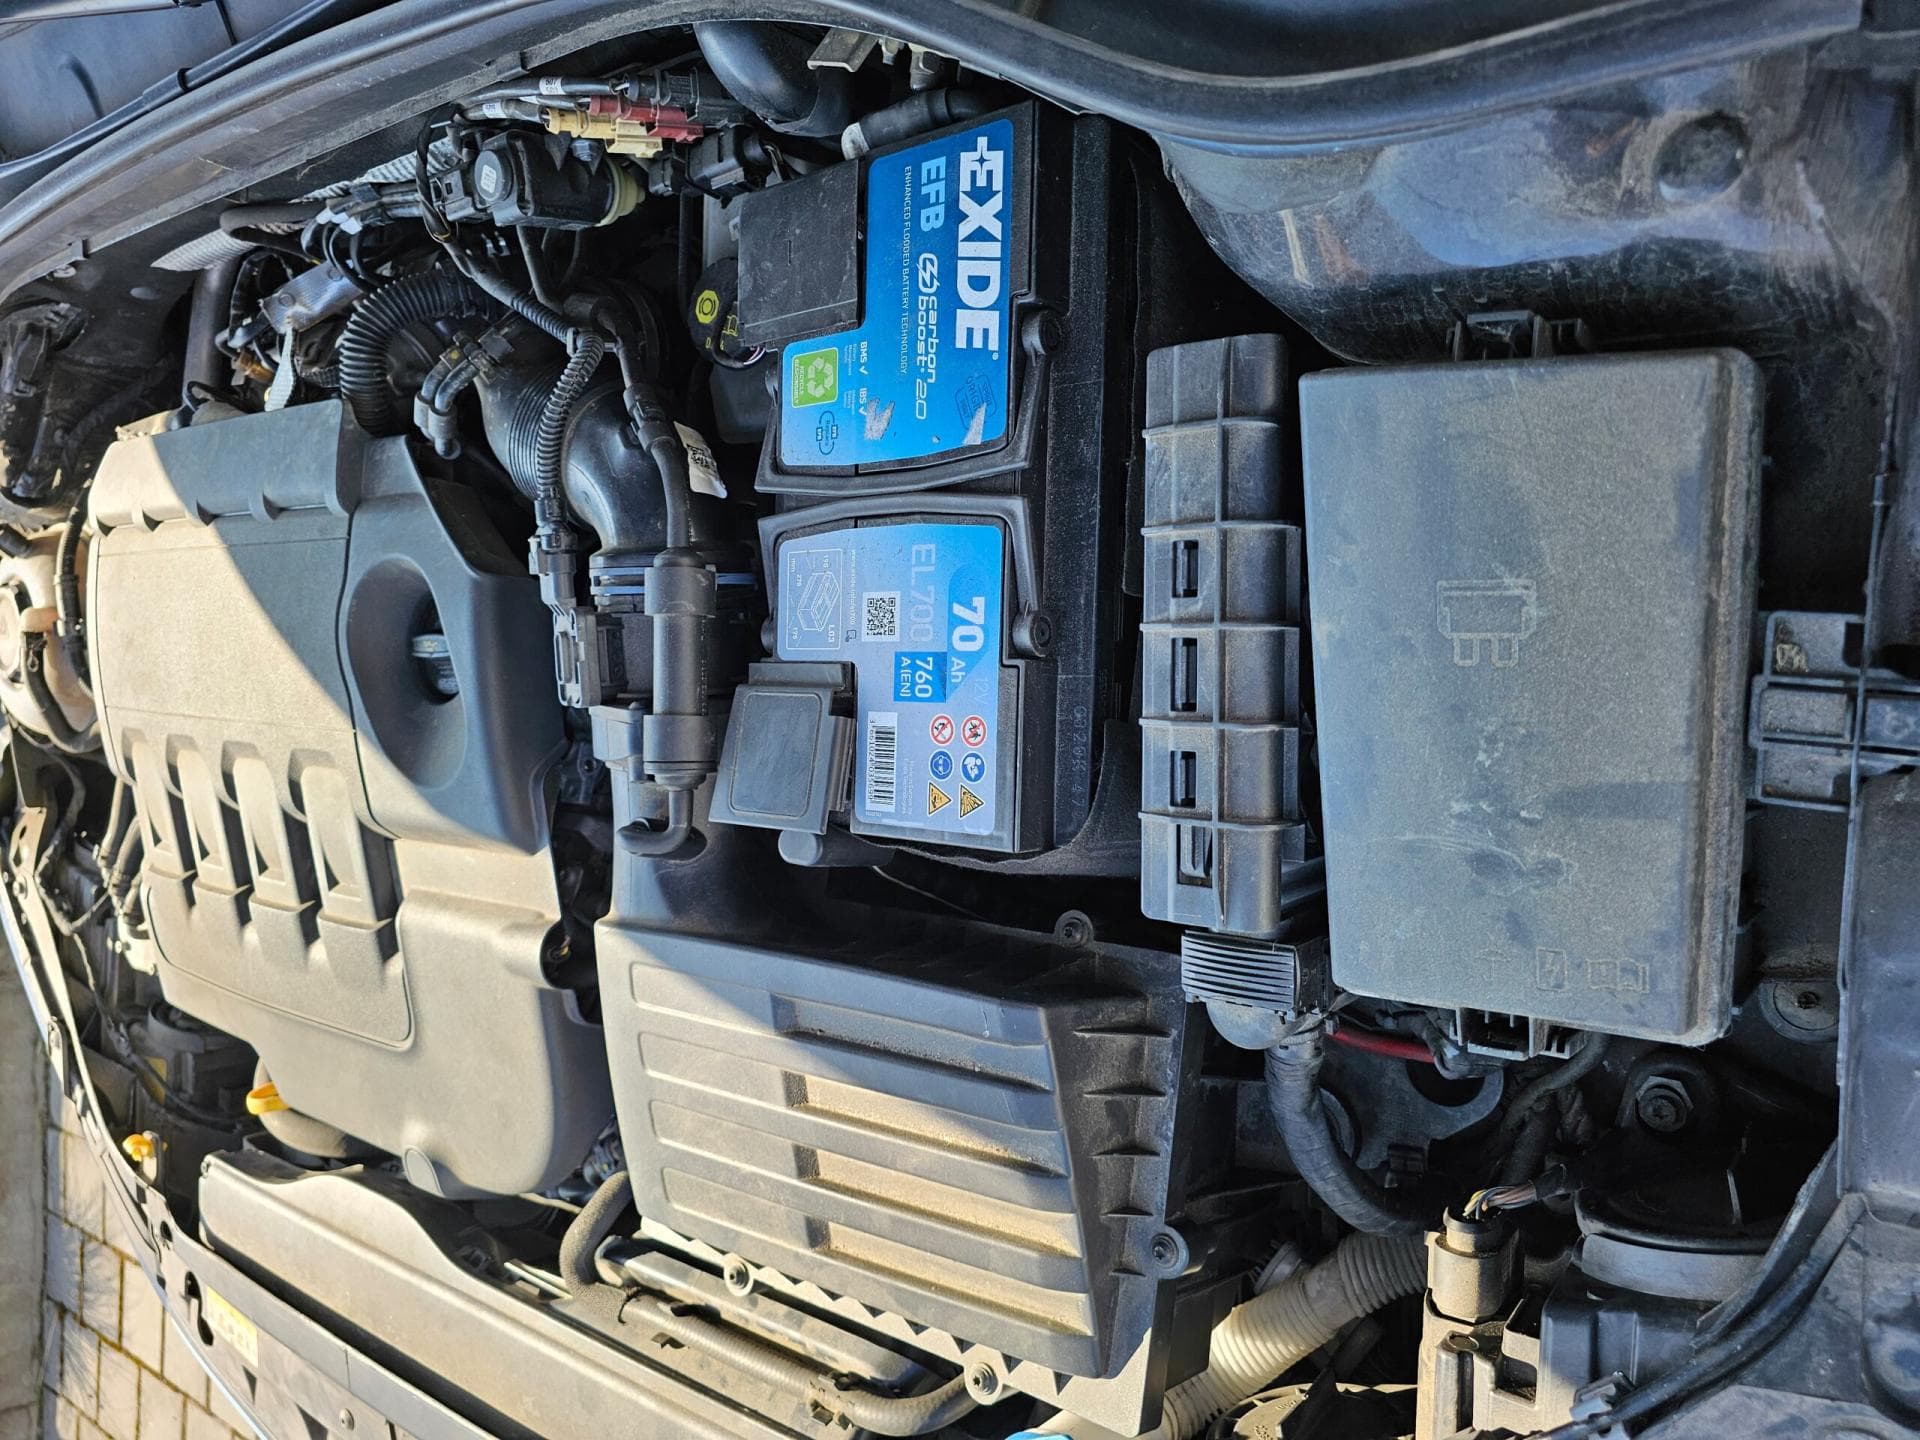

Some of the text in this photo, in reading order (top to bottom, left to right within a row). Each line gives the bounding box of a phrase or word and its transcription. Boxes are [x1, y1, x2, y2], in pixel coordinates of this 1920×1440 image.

[920, 156, 947, 232] EFB
[900, 166, 912, 375] ENHANCED FLOODED BATTERY TECHNOLOGY
[955, 136, 1004, 351] EXIDE
[860, 341, 868, 363] BMS
[916, 295, 928, 367] boost
[927, 295, 939, 383] carbon
[859, 388, 867, 404] IBS
[910, 543, 936, 642] EL700
[899, 656, 912, 697] A (EN)
[915, 656, 933, 698] 760
[950, 596, 986, 683] 70 Ah
